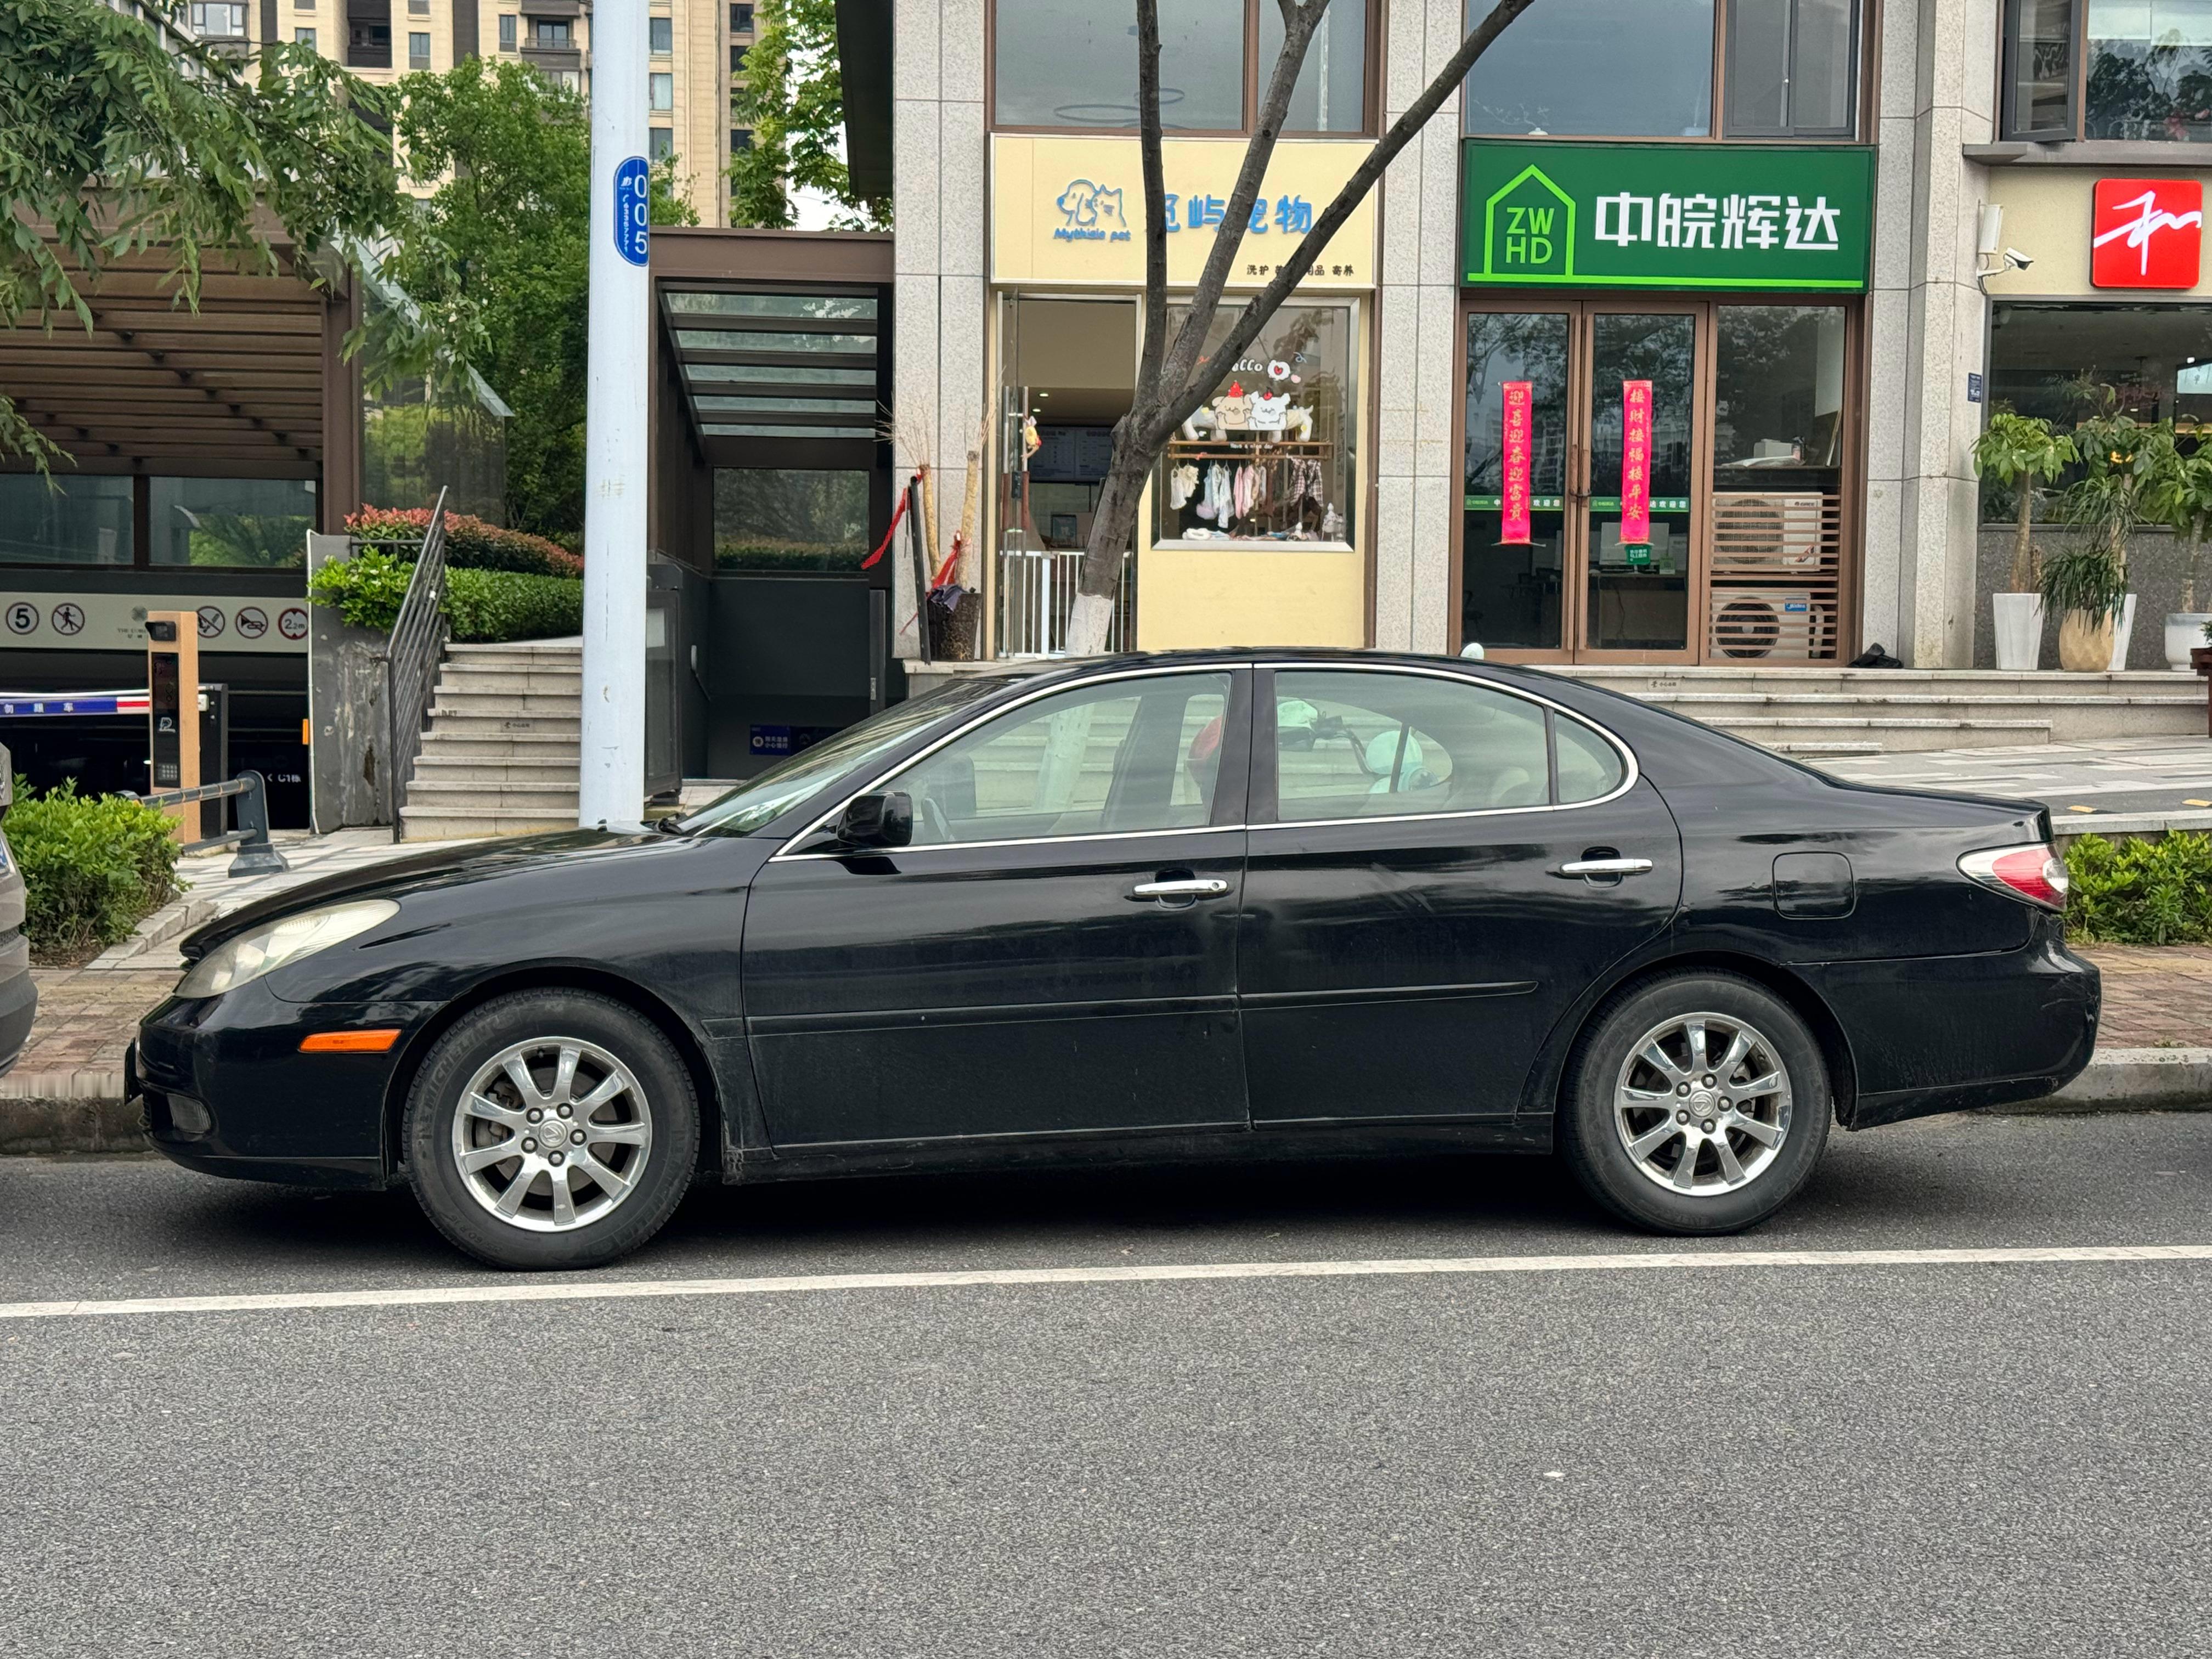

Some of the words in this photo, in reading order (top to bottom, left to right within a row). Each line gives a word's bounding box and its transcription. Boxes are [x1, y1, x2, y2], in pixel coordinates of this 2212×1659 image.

[634, 174, 647, 255] 005
[1506, 207, 1555, 235] ZW
[1595, 192, 1841, 250] 中皖辉达
[1109, 229, 1131, 242] pet
[1505, 241, 1554, 264] HD
[1232, 359, 1263, 372] ello
[15, 608, 30, 629] 5
[421, 1019, 492, 1109] MICHELIN
